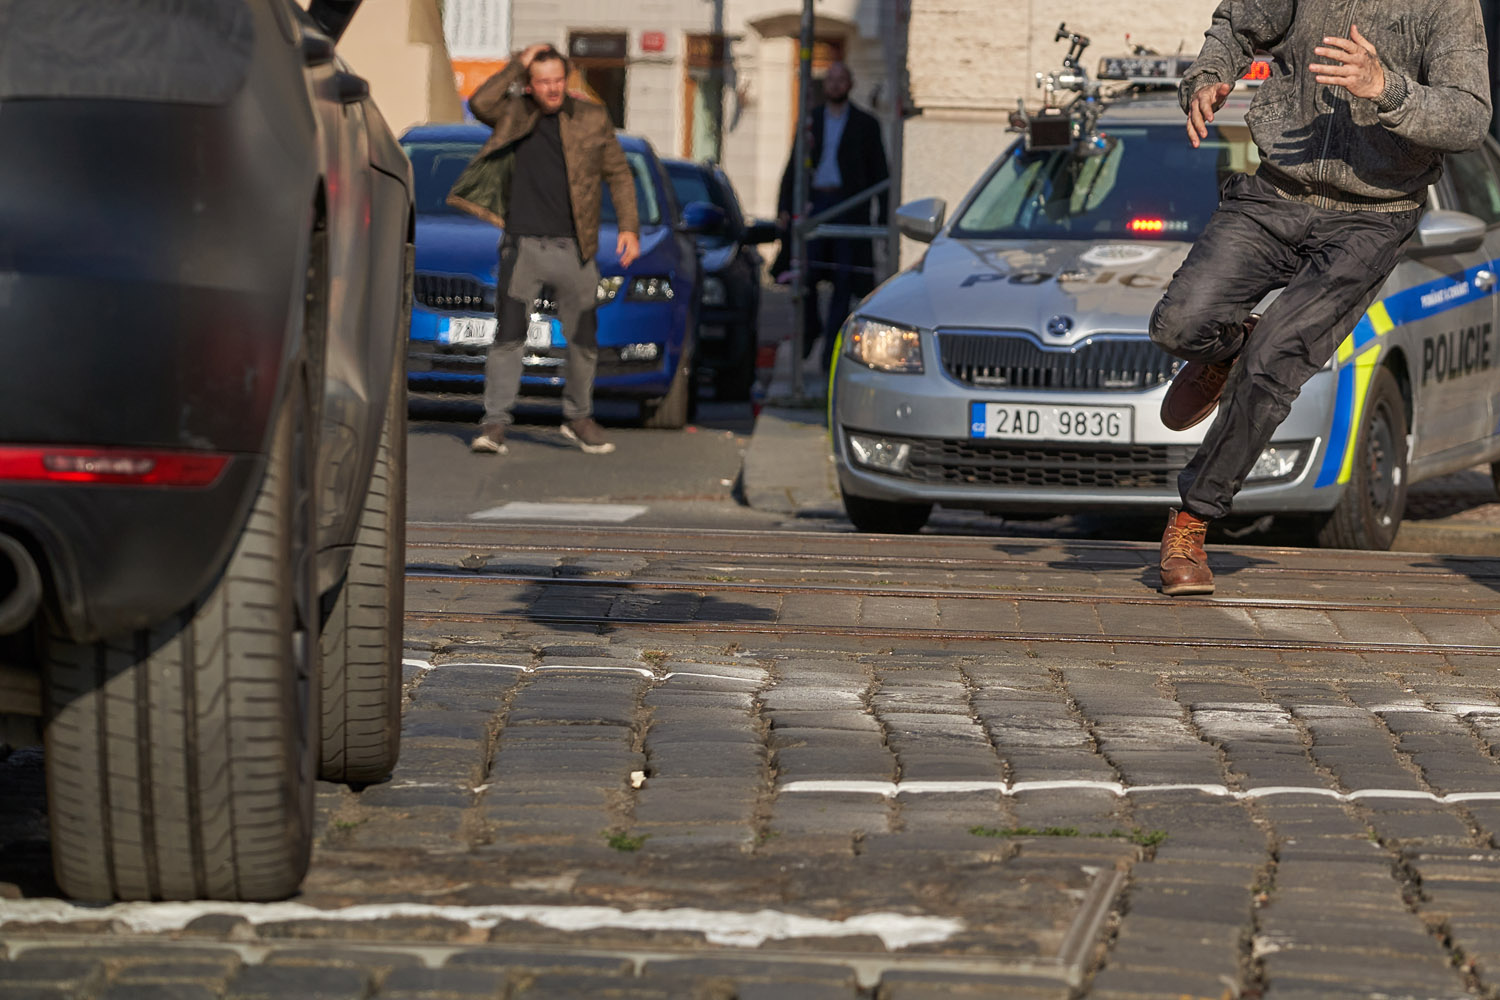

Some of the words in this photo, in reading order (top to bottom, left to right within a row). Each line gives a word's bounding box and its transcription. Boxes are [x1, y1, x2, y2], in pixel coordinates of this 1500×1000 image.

[960, 271, 1169, 290] POLIC
[1422, 323, 1492, 387] POLICIE
[996, 409, 1040, 434] 2AD
[1058, 411, 1120, 437] 983G
